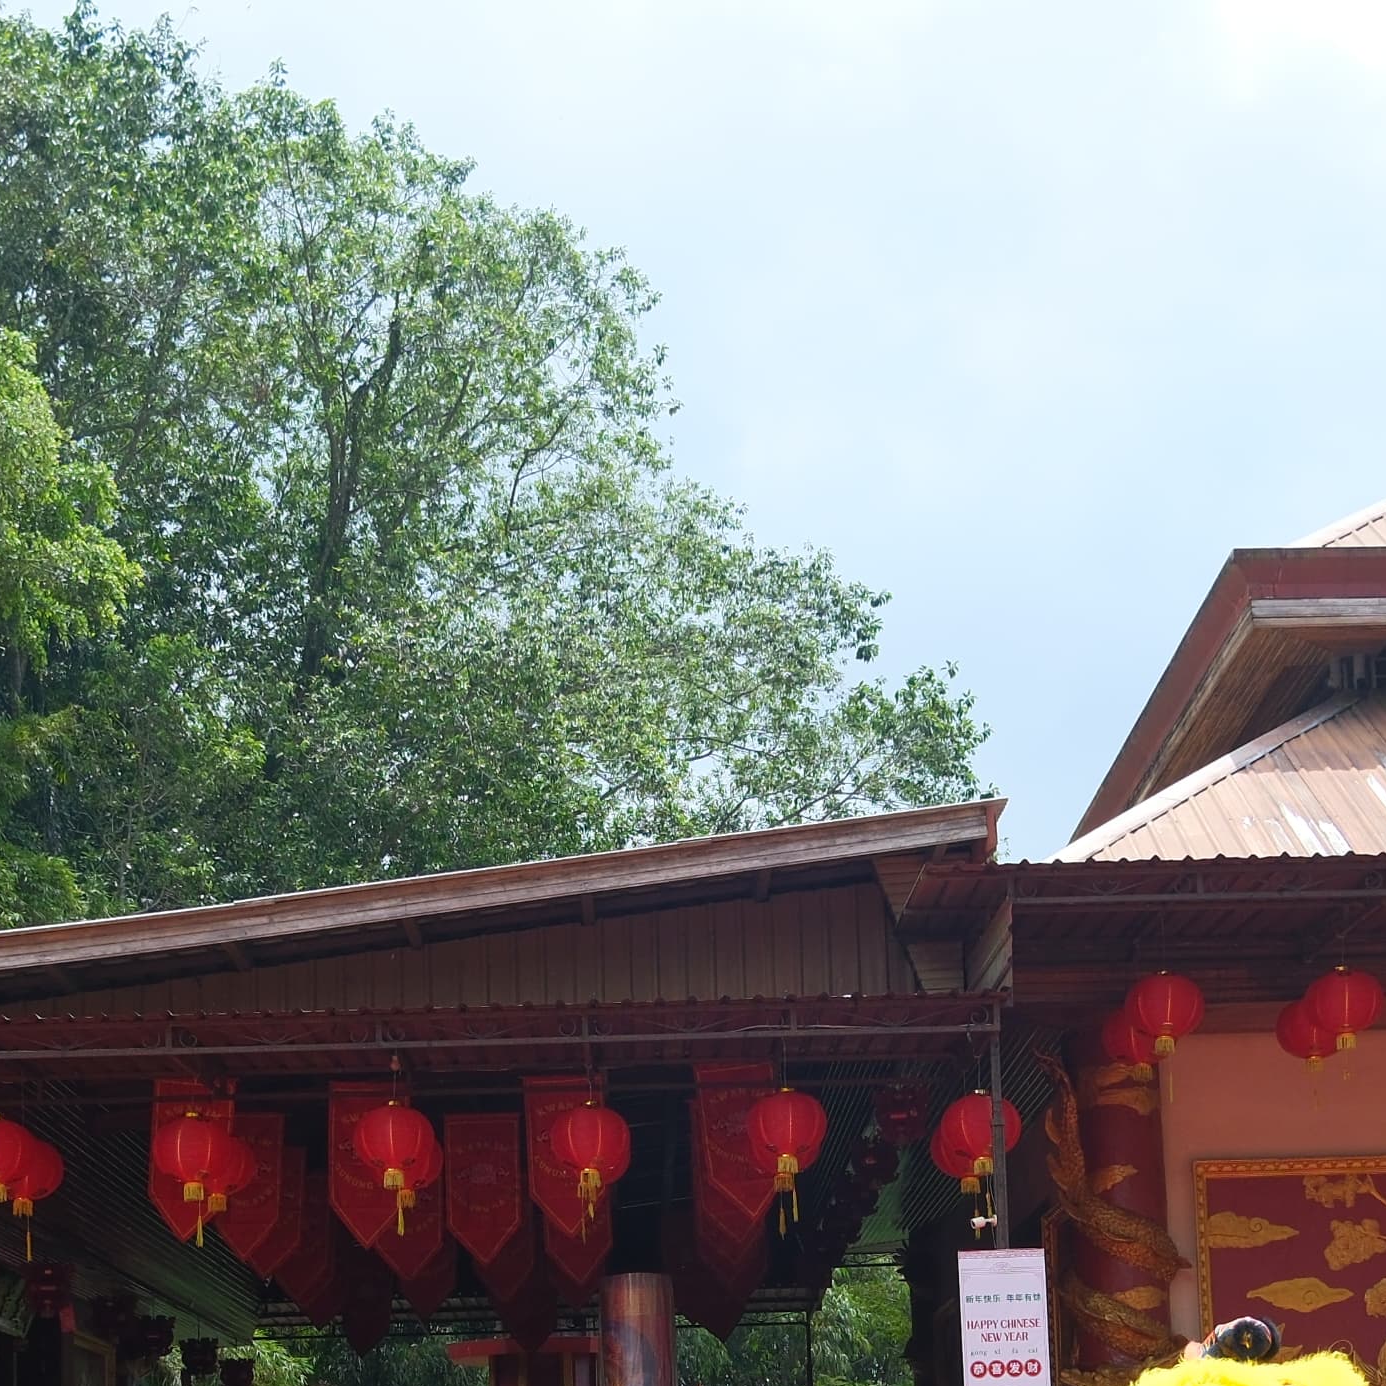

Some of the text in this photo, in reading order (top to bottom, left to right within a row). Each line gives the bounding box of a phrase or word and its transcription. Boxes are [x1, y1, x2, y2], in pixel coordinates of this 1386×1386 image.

[966, 1318, 1041, 1330] HAPPY CHINESE
[980, 1331, 1028, 1342] NEW YEAR
